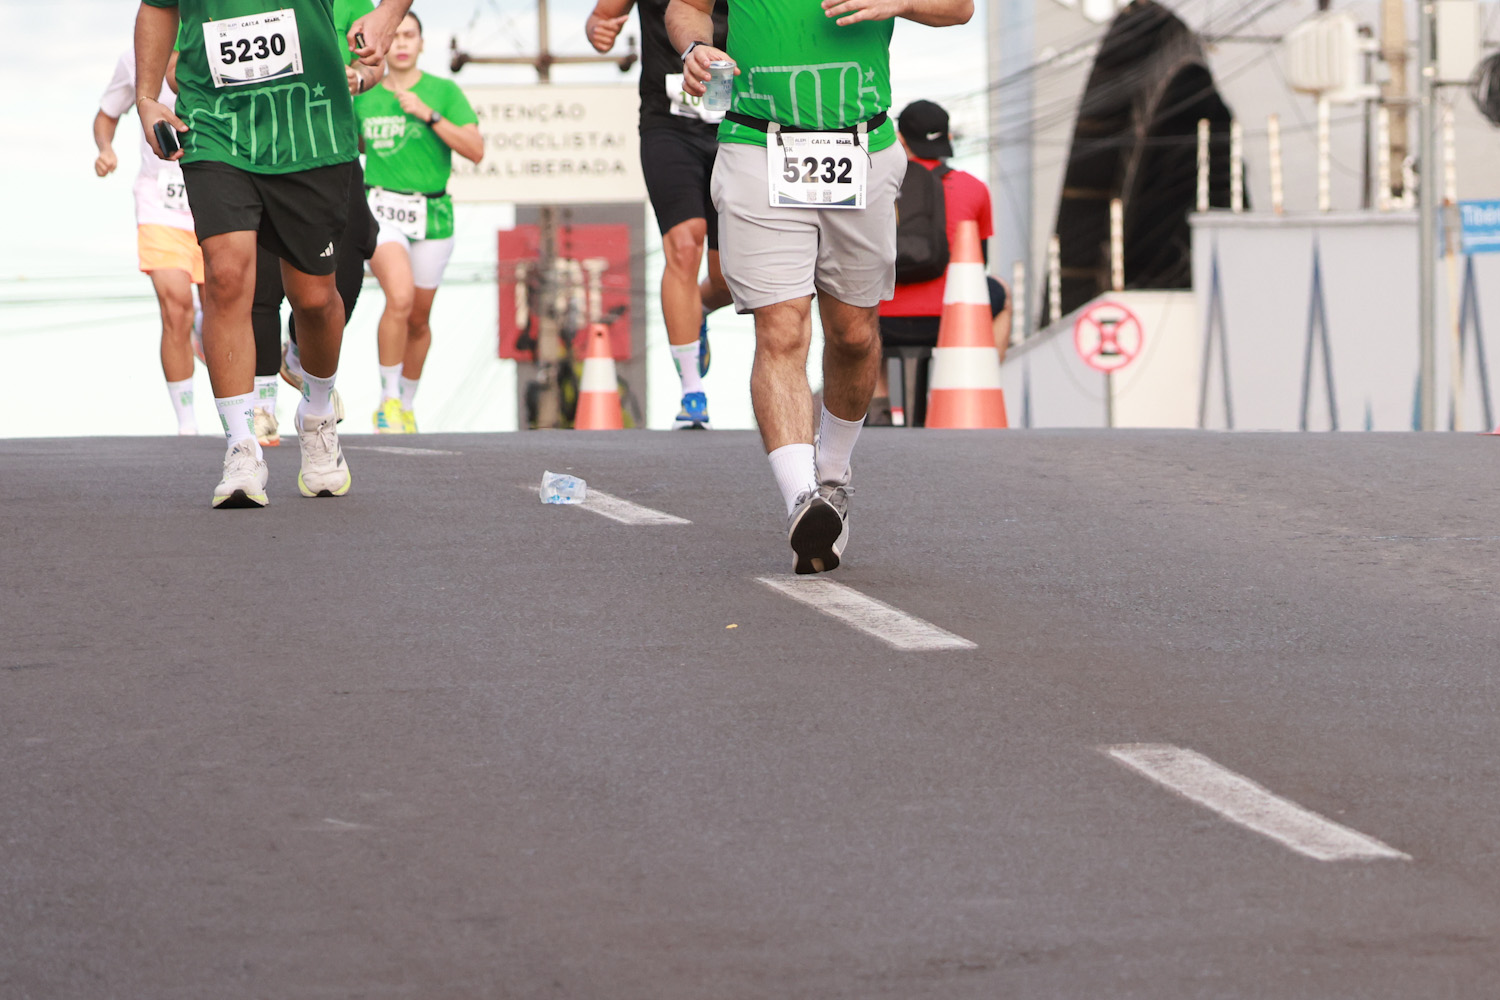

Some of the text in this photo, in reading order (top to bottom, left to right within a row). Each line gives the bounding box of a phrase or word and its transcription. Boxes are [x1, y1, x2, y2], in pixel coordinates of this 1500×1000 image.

[219, 33, 286, 65] 5230
[679, 91, 701, 106] 10
[451, 160, 627, 177] AIXA LIBERADA
[782, 156, 852, 184] 5232
[167, 183, 185, 198] 57
[376, 205, 417, 223] 5305
